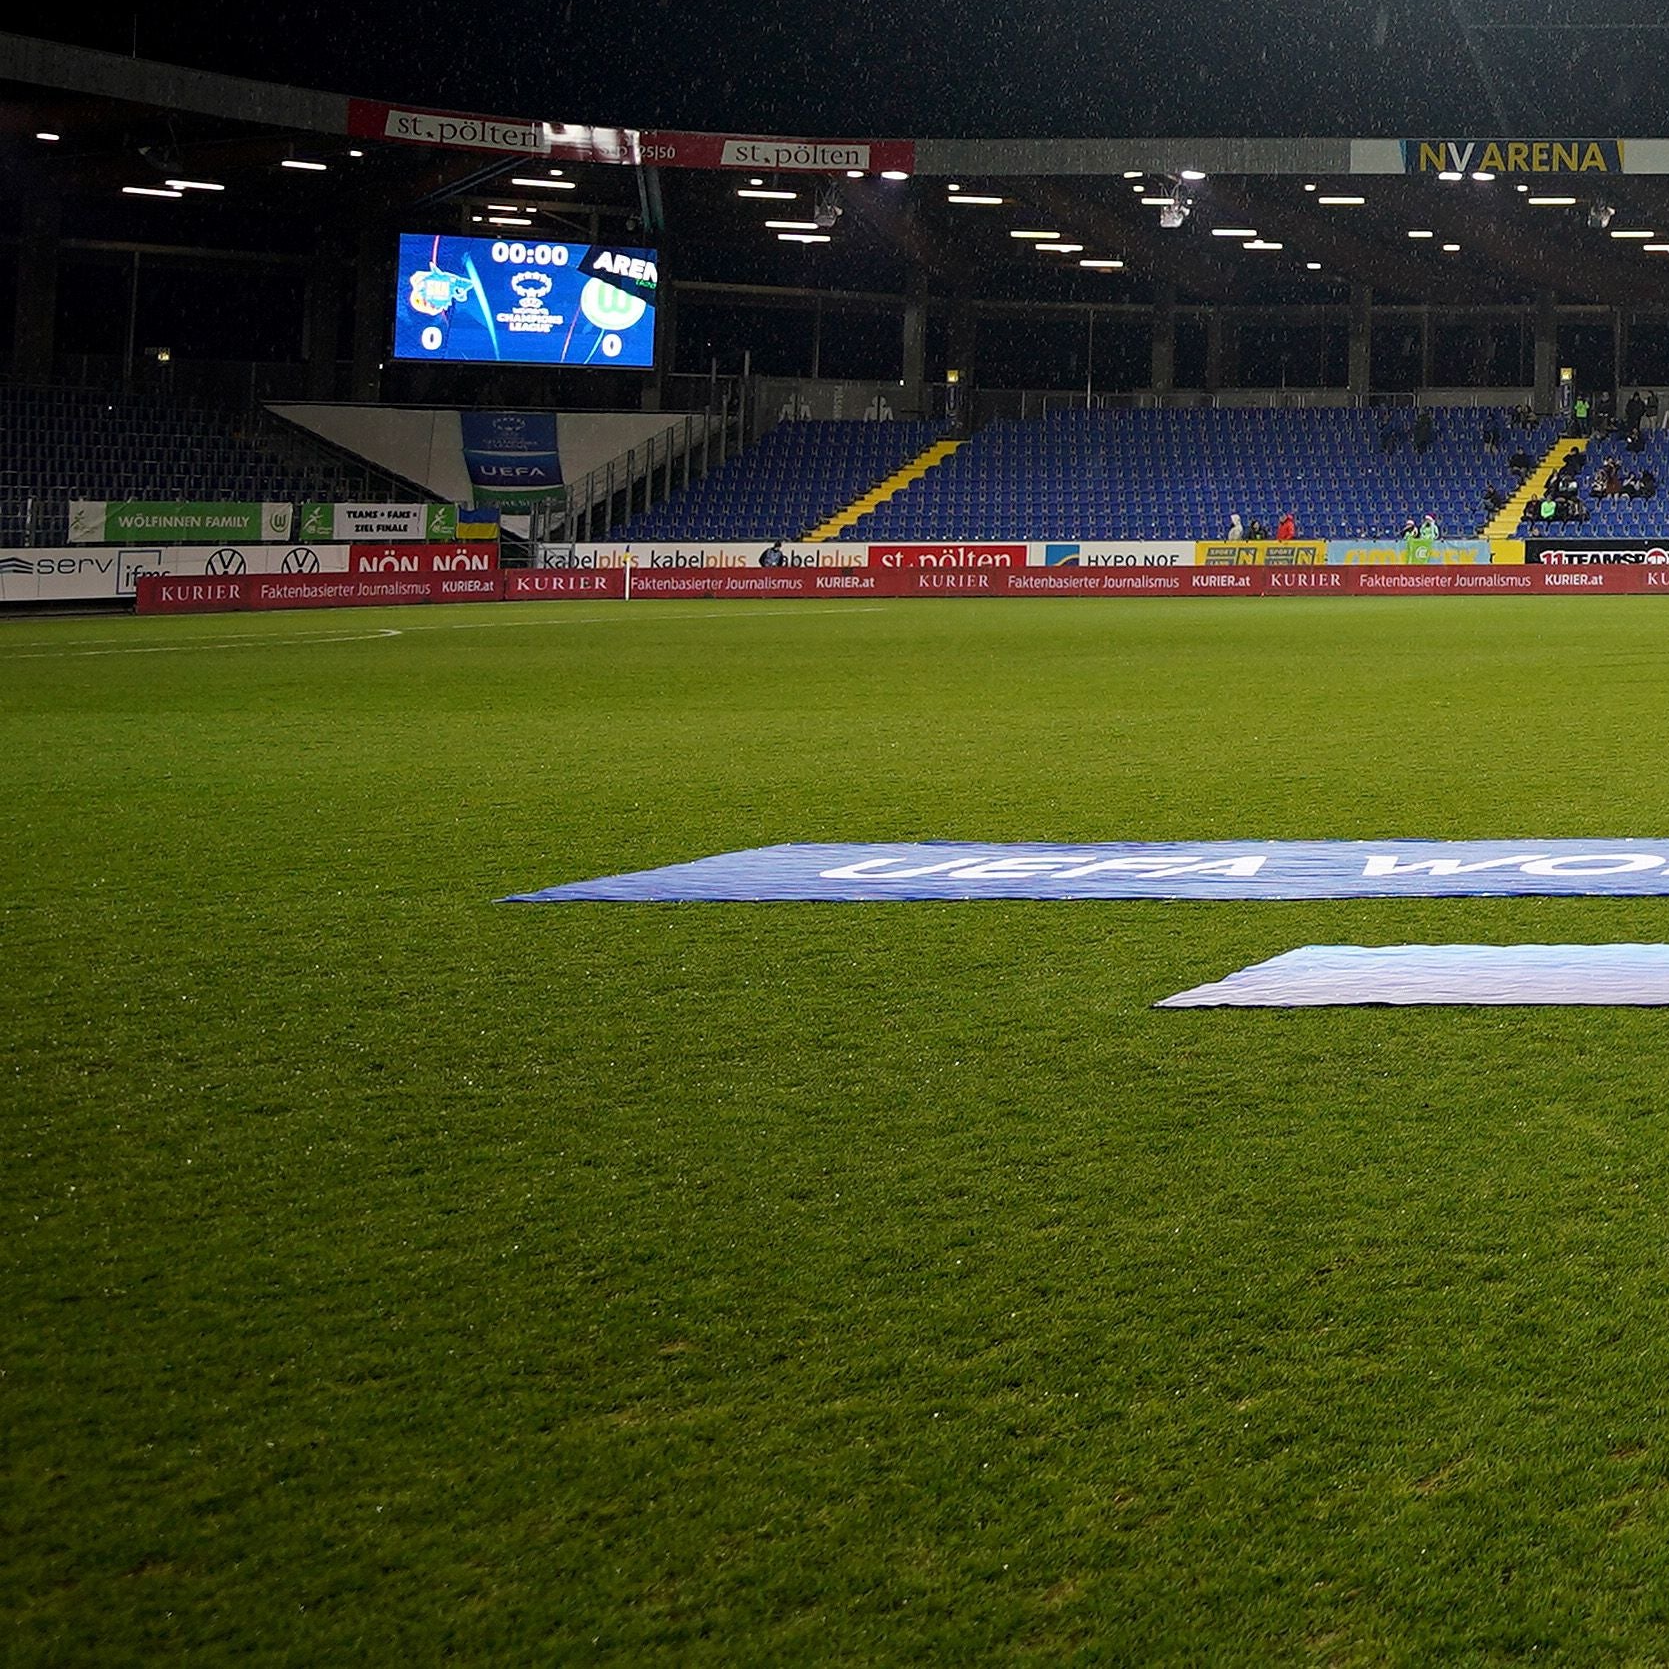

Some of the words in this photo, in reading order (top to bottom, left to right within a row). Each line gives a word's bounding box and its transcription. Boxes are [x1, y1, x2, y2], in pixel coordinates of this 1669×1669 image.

[1479, 142, 1608, 171] ARENA
[491, 241, 569, 267] 00:00
[421, 326, 443, 351] 0
[602, 333, 623, 357] 0
[480, 465, 545, 477] UEFA
[118, 513, 200, 530] WÖLFINNEN
[204, 515, 250, 530] FAMILY
[354, 524, 374, 532] ZIEL
[376, 524, 409, 532] FINALE
[37, 558, 114, 575] serv
[781, 549, 863, 567] abelplus
[516, 577, 608, 591] KURIER
[631, 576, 722, 592] Faktenbasierter
[724, 575, 803, 591] Journalismus
[816, 575, 875, 588] KURIER.at
[918, 574, 990, 587] KURIER
[1007, 574, 1100, 590] Faktenbasierter
[1101, 574, 1180, 590] Journalismus
[1191, 574, 1251, 587] KURIER.at
[1270, 573, 1341, 587] KURIER
[1359, 573, 1452, 588] Faktenbasierter
[1453, 573, 1532, 588] Journalismus
[1544, 572, 1604, 586] KURIER.at
[161, 585, 241, 601] KURIER
[260, 581, 353, 600] Faktenbasierter
[356, 579, 431, 597] Journalismus
[441, 580, 495, 594] KURIER.at
[819, 854, 1270, 880] UEFA
